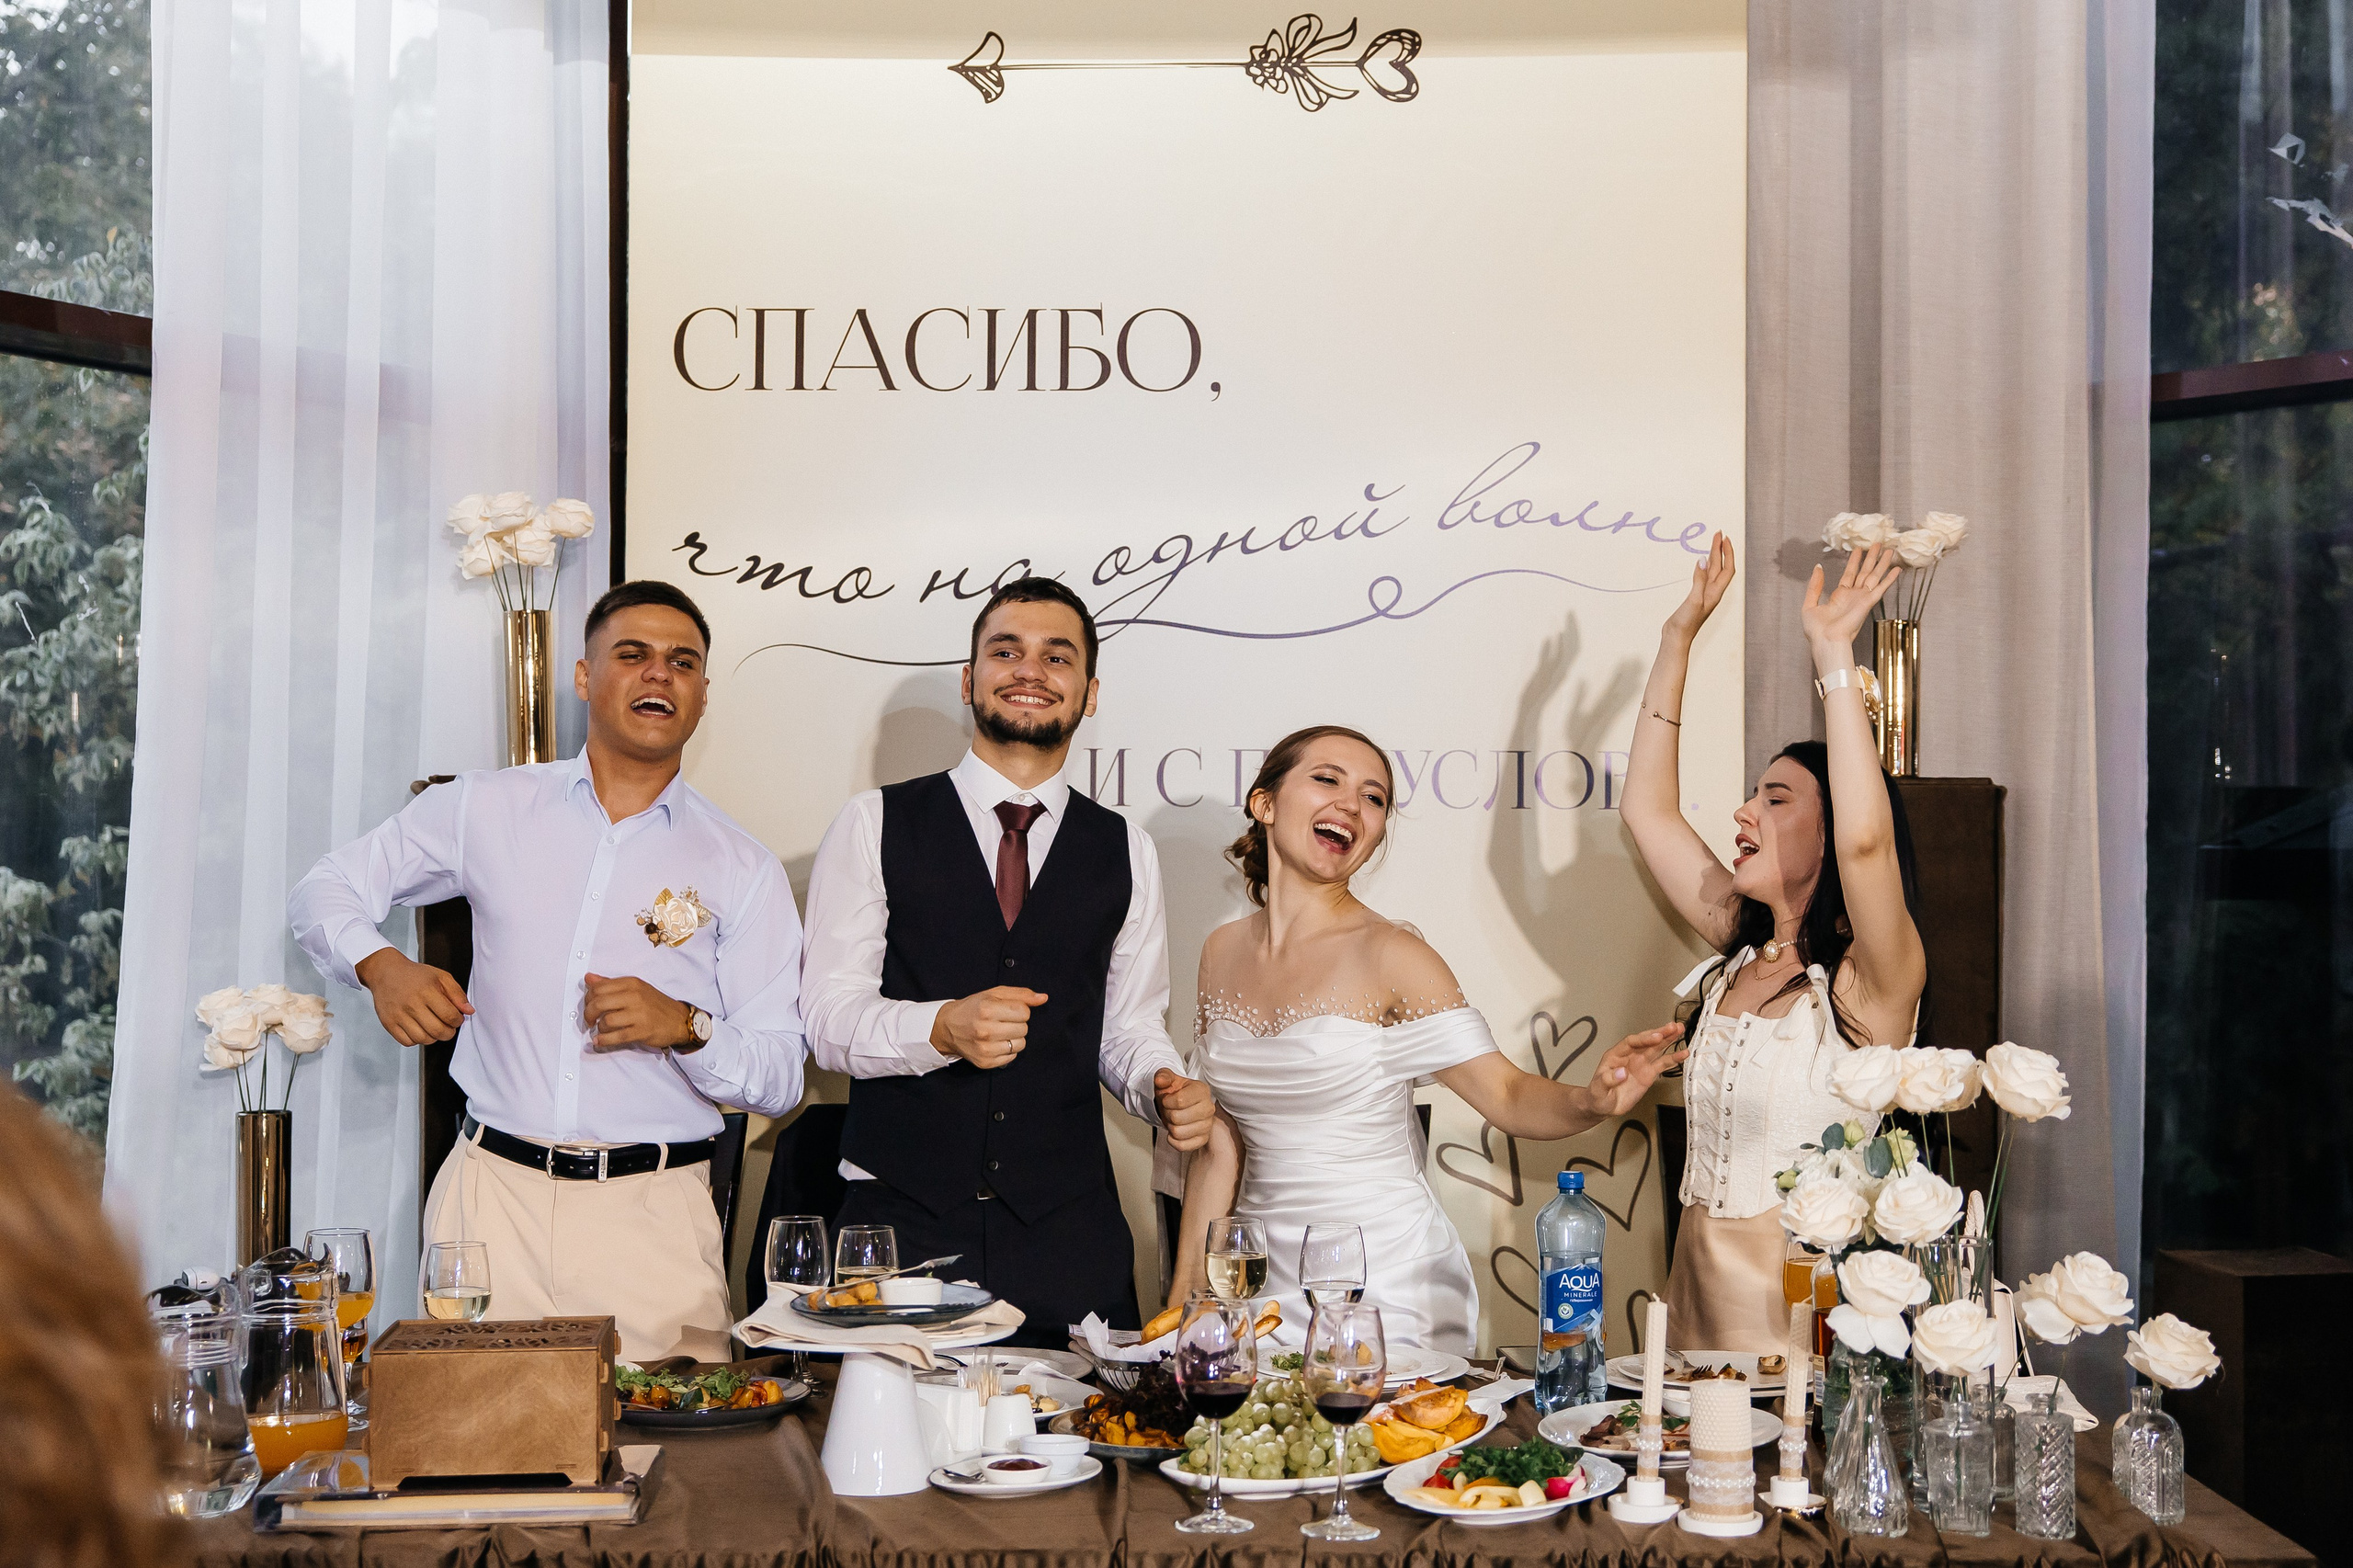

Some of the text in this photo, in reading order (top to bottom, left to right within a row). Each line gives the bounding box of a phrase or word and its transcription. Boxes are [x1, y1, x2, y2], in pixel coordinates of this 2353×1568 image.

[673, 302, 1222, 402] СПАСИБО,
[672, 530, 895, 604] что
[1091, 483, 1410, 642] одной
[1437, 441, 1710, 554] волне
[1083, 746, 1131, 807] И
[1155, 745, 1205, 808] С
[1558, 1272, 1600, 1292] AQUA
[1563, 1290, 1597, 1299] MINERALE
